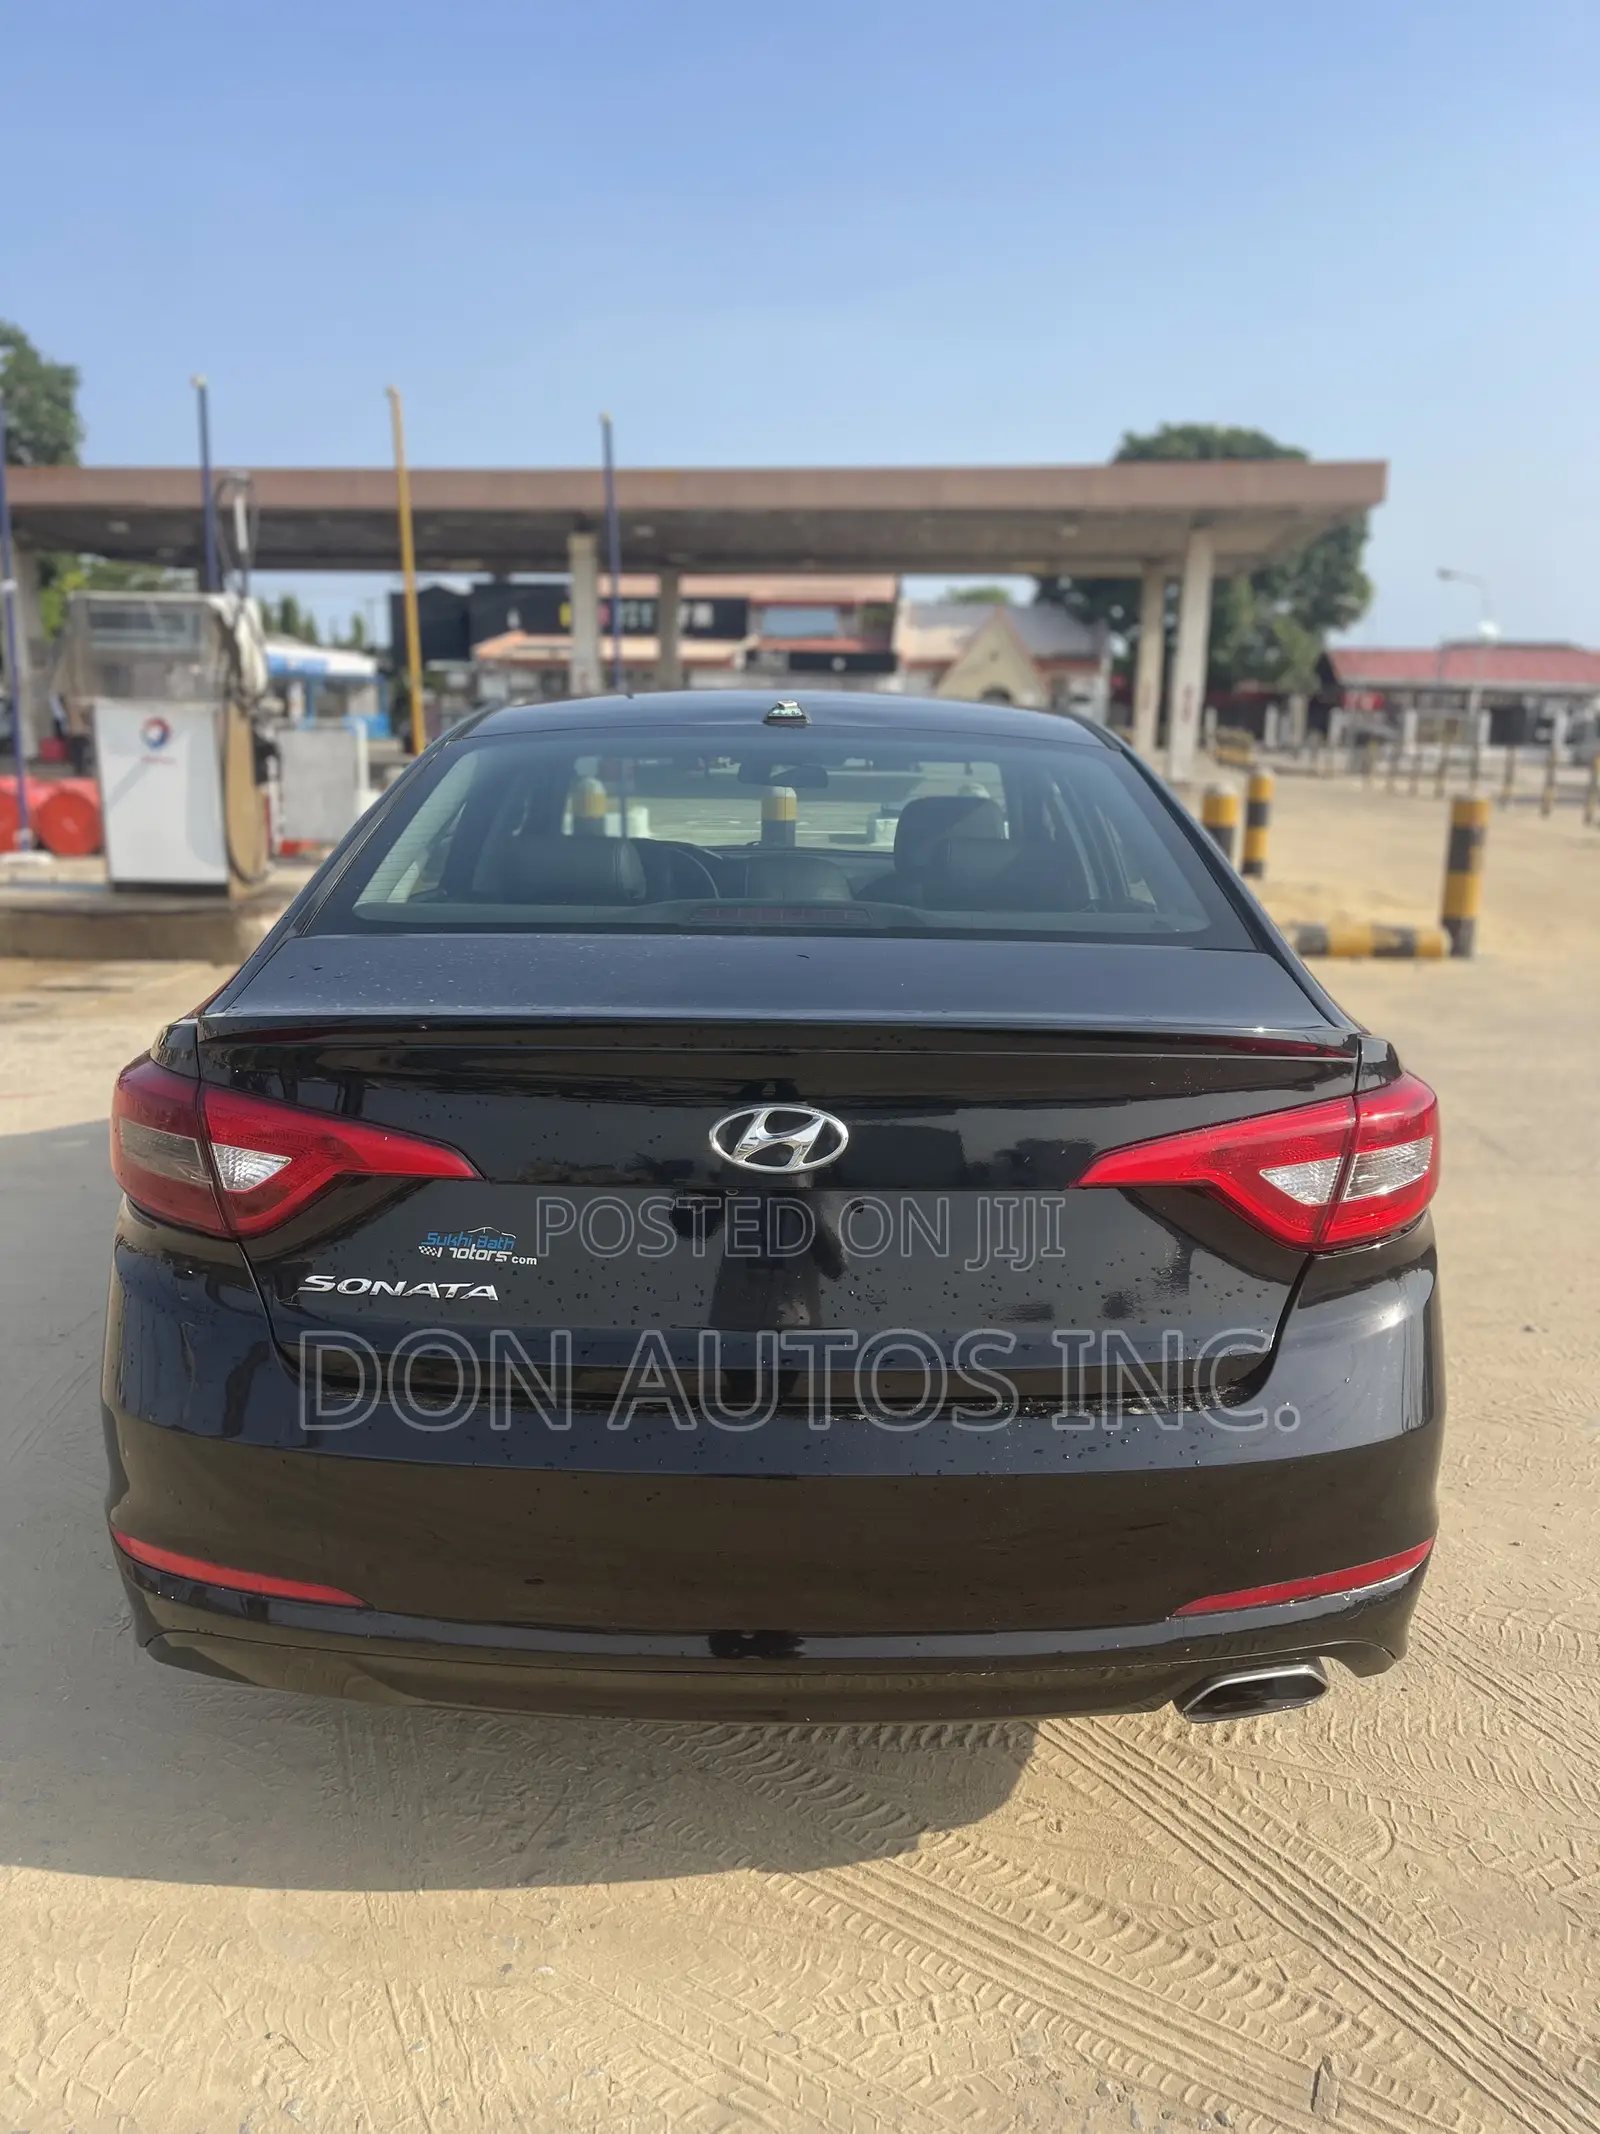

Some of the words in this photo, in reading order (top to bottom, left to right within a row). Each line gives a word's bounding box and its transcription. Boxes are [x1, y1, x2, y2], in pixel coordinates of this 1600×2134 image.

[421, 1231, 473, 1248] Sukhi
[476, 1235, 515, 1251] Bath
[298, 1274, 499, 1301] SONATA
